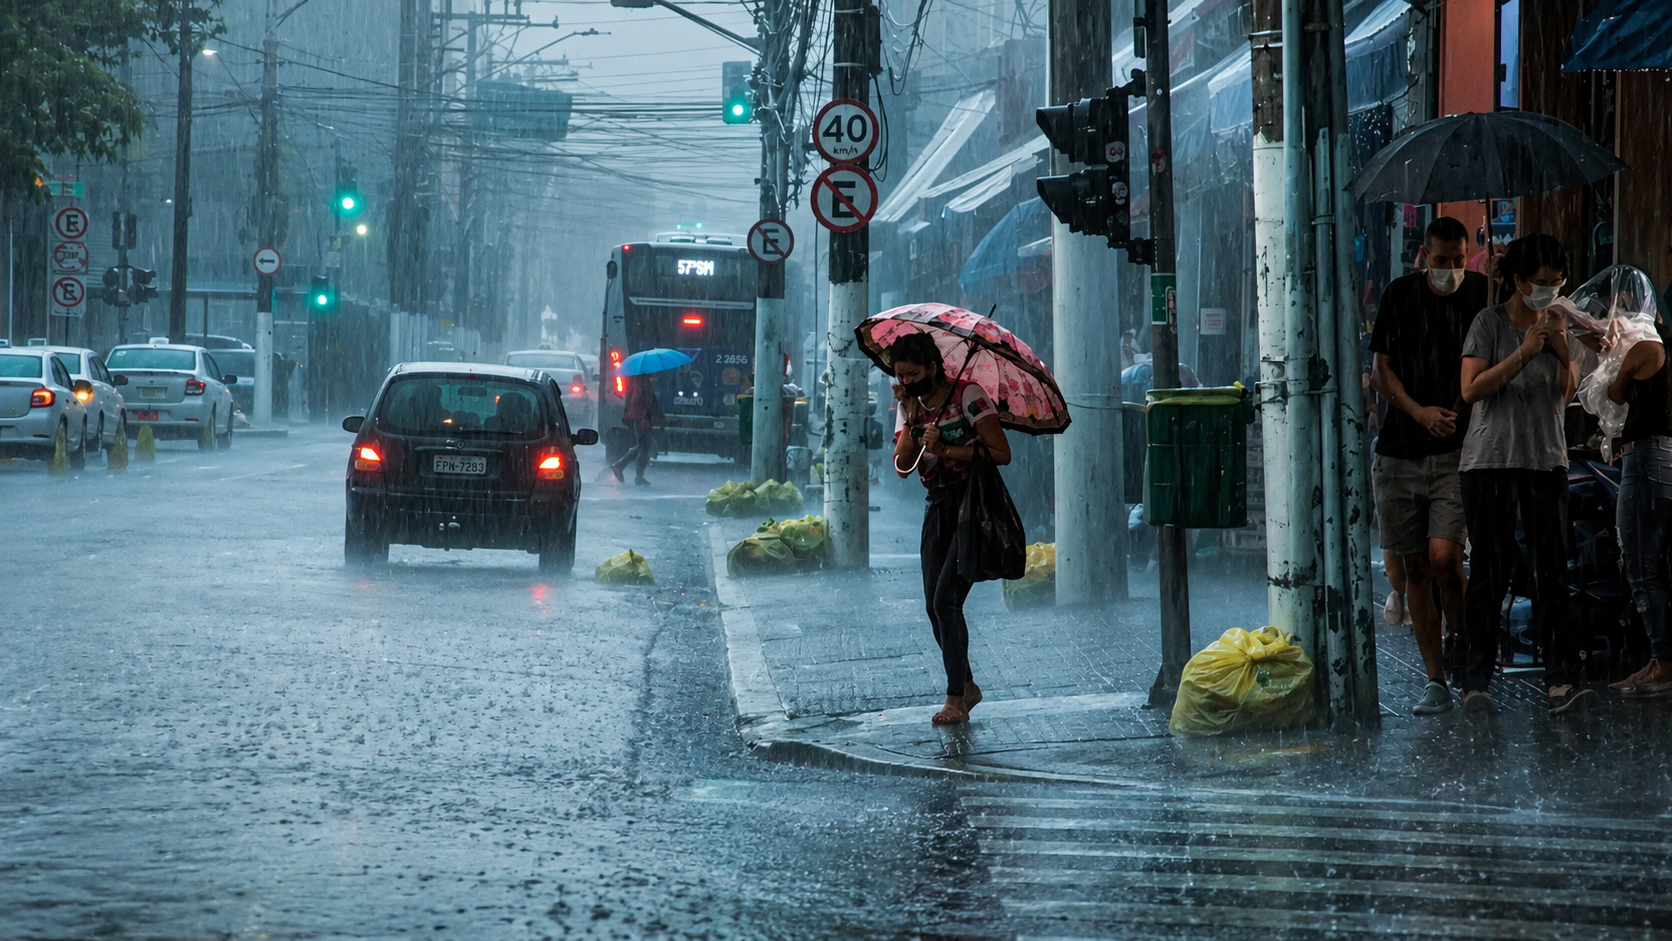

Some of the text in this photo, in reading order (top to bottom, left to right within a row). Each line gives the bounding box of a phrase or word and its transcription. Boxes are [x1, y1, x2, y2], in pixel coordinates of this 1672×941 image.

[822, 114, 867, 143] 40
[832, 181, 856, 218] E
[65, 214, 80, 233] E
[763, 228, 780, 255] E
[63, 283, 77, 301] E
[436, 460, 484, 472] FPN-7283
